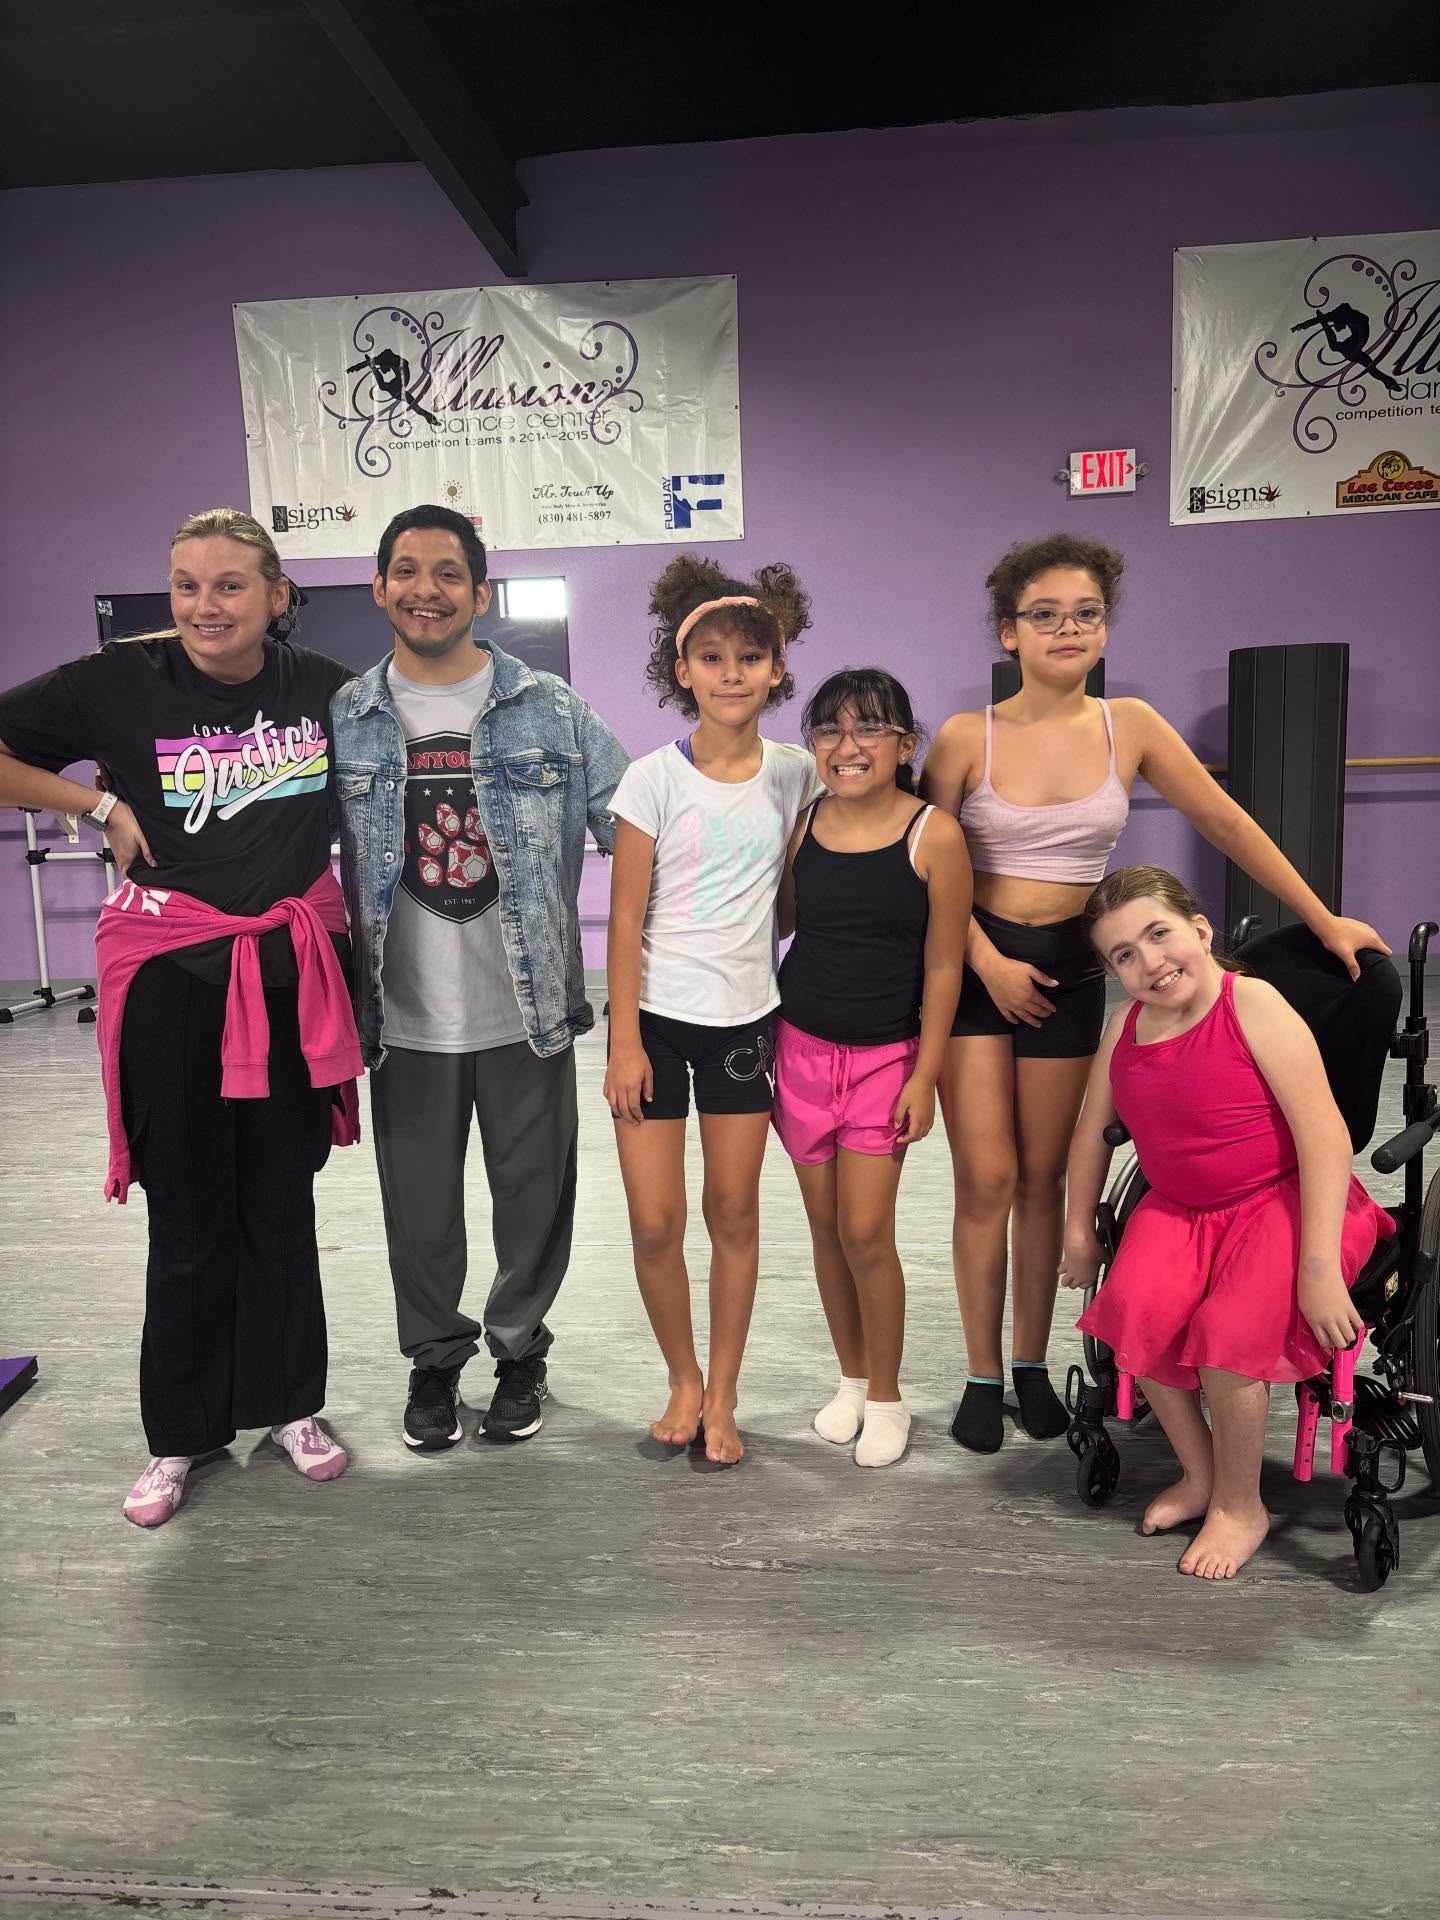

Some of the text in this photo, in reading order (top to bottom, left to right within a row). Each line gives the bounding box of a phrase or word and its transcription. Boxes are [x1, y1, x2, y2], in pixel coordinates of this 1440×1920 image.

[355, 327, 608, 420] Illusion
[430, 407, 612, 434] dance center
[1335, 405, 1423, 421] competition
[388, 430, 589, 450] competition teams 2014-2015
[1081, 451, 1127, 489] EXIT
[532, 483, 614, 500] Mr. Touch Up
[1205, 482, 1269, 511] signs
[1342, 490, 1438, 503] MEXICAN CAFE
[1347, 480, 1434, 494] Los Cucos
[662, 477, 673, 530] FUQUAY
[1243, 500, 1277, 511] DESIGN
[288, 502, 346, 530] signs
[538, 510, 611, 525] (830) 481-5897
[193, 723, 234, 737] LOVE
[174, 709, 320, 834] Justice
